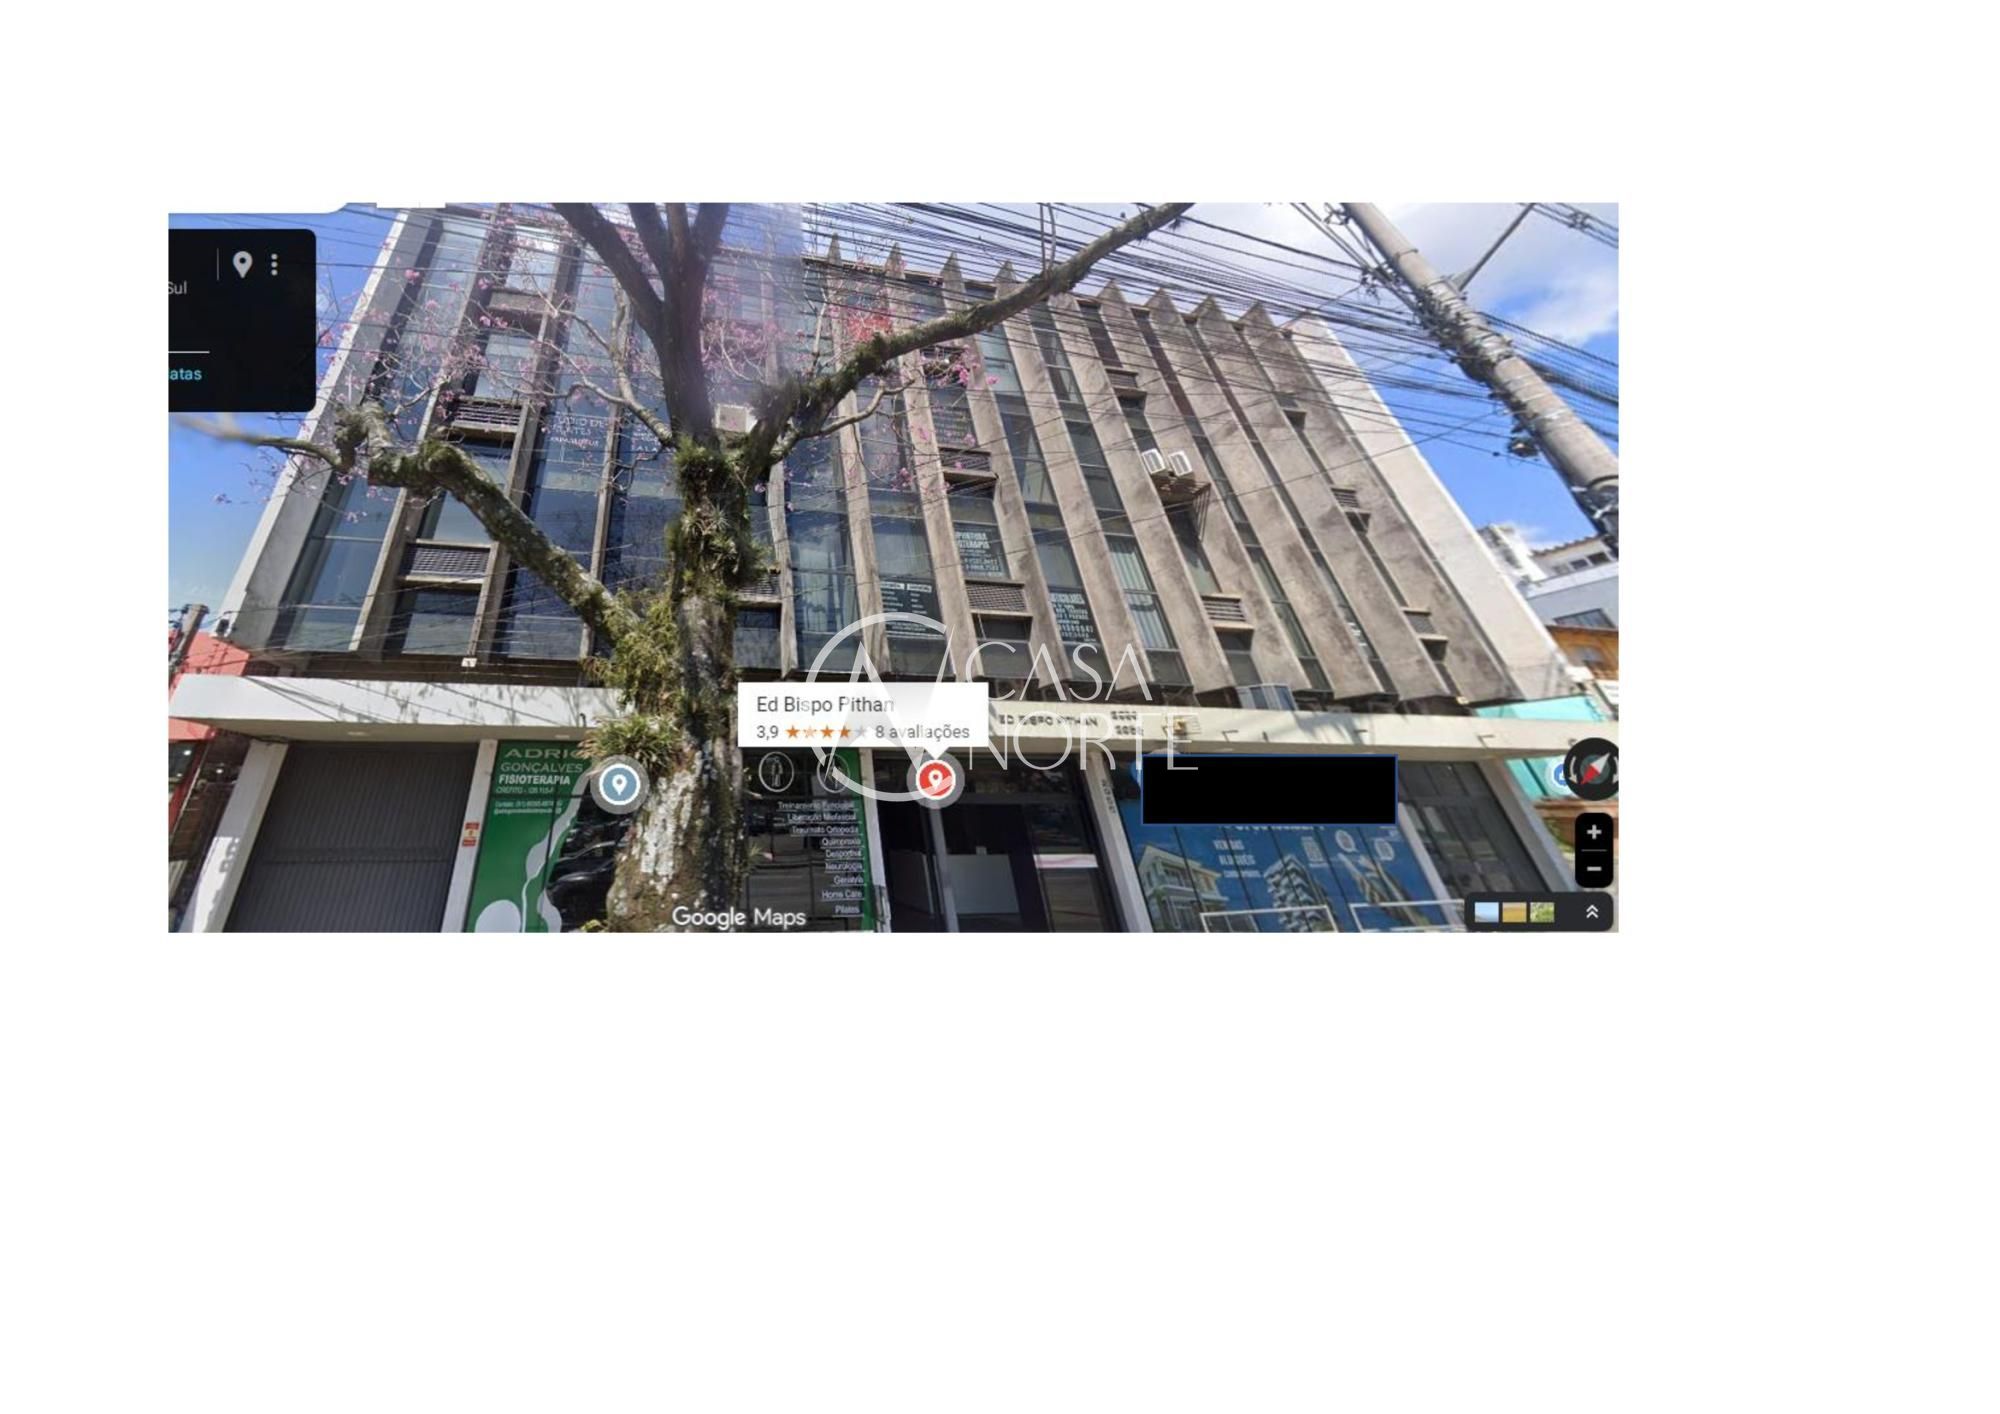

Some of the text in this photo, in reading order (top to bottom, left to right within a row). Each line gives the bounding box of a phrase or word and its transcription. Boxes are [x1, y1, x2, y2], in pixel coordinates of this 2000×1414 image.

[500, 762, 584, 774] GONÇALVES
[498, 774, 571, 785] FISIOTERAPIA
[822, 890, 843, 899] Home
[834, 905, 860, 914] Pilates
